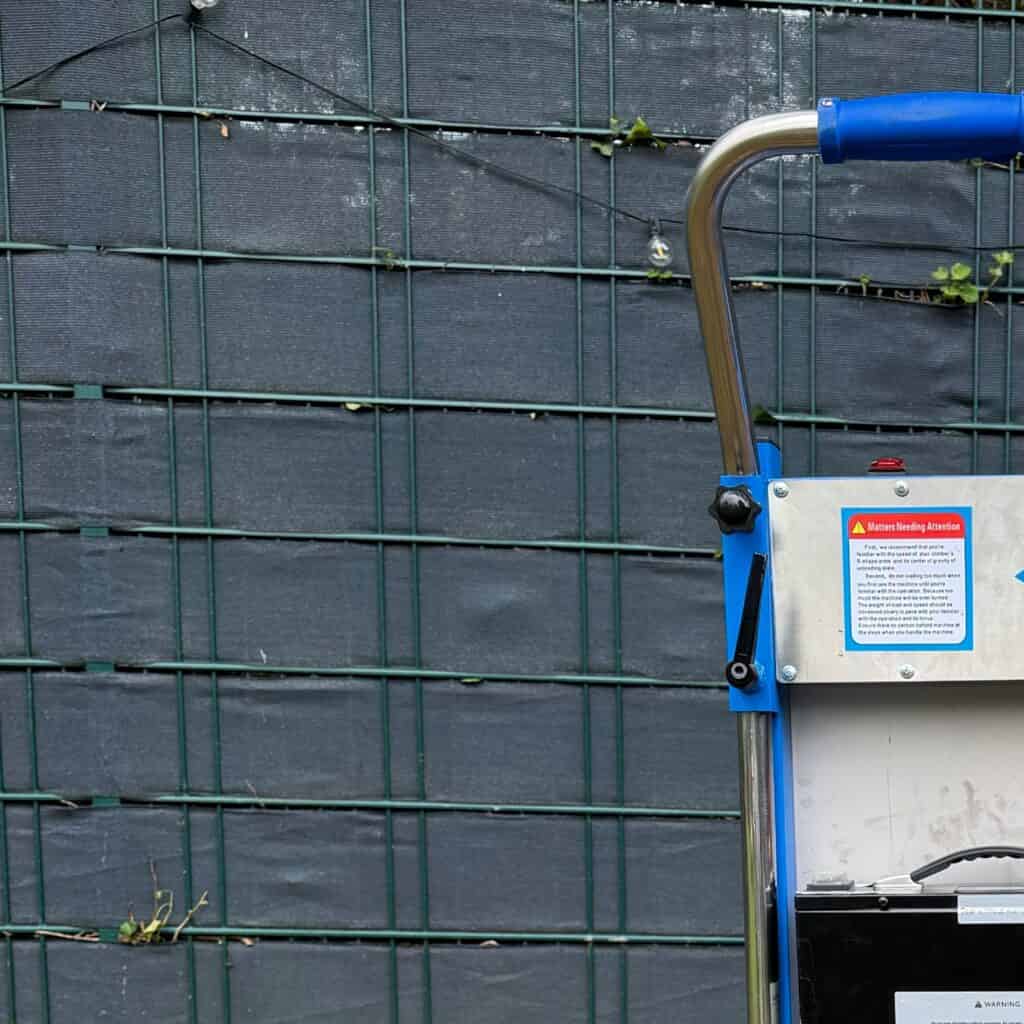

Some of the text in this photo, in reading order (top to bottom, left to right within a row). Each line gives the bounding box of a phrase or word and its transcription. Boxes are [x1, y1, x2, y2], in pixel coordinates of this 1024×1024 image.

[868, 521, 961, 533] Matters Needing Attention
